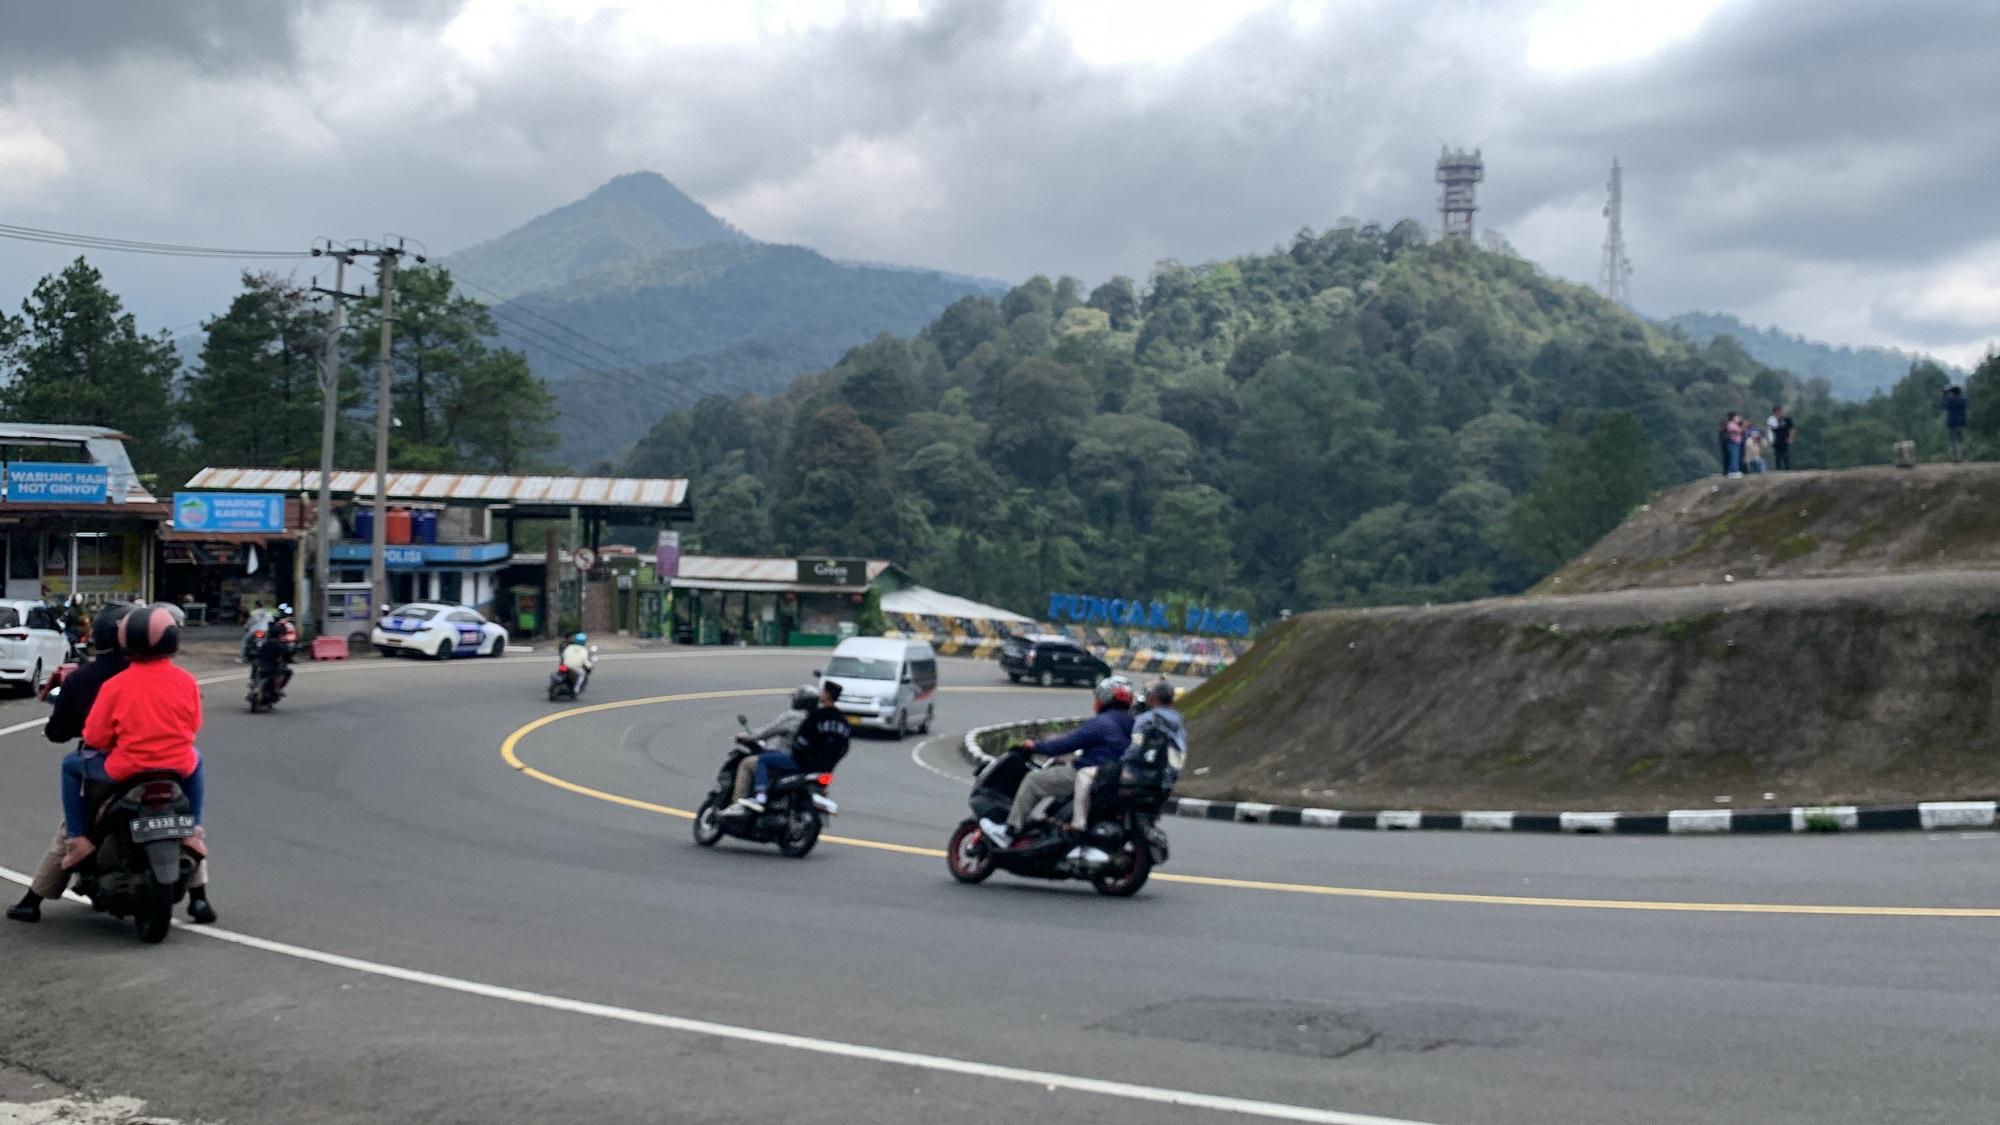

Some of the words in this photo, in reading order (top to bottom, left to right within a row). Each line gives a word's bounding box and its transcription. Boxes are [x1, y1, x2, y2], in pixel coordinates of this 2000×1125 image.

[12, 471, 73, 482] WARUNG
[18, 483, 47, 494] HOT
[213, 499, 265, 508] WARUNG
[384, 549, 422, 562] POLISI
[813, 562, 848, 577] Green
[1048, 592, 1169, 629] PUNCAK
[1185, 607, 1249, 636] PASS
